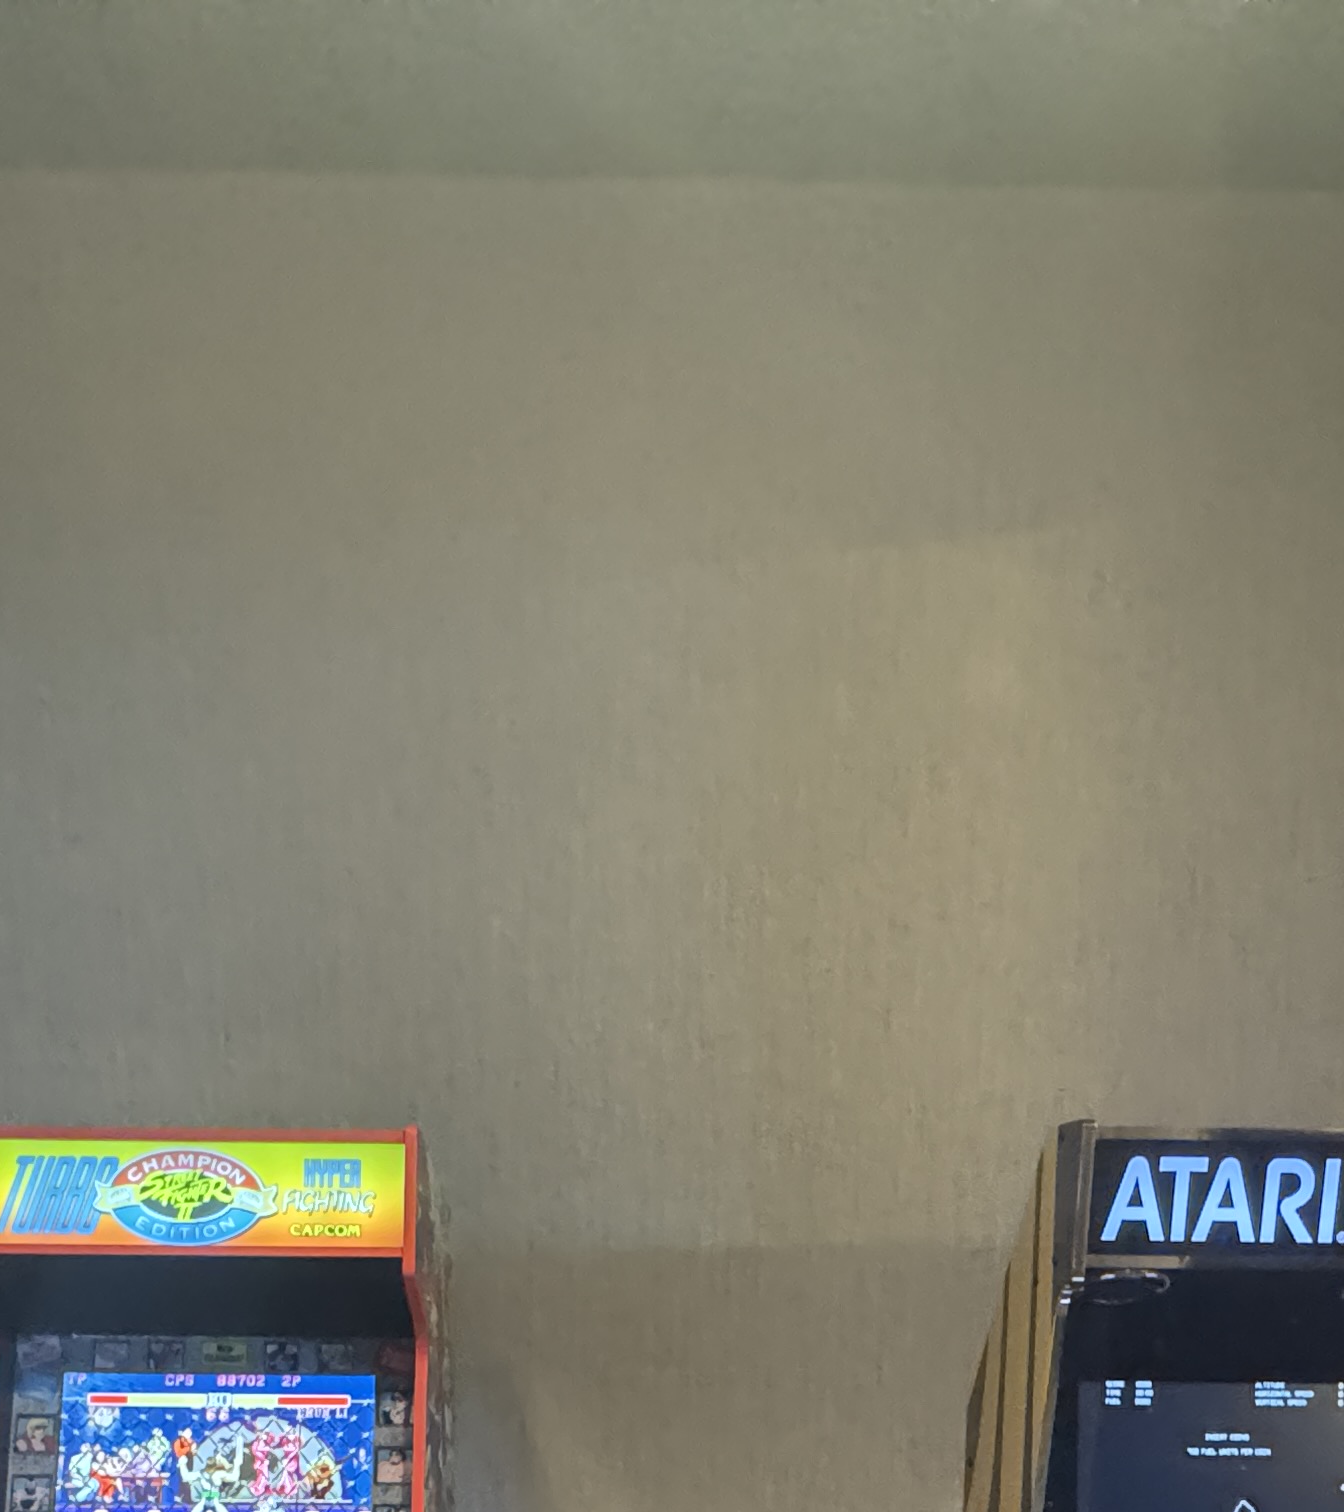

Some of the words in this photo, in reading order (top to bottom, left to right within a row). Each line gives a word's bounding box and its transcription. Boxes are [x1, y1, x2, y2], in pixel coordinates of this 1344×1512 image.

[127, 1153, 246, 1185] CHAMPION
[303, 1158, 362, 1188] HYPER
[283, 1188, 376, 1216] FIGHTING
[1101, 1156, 1342, 1244] ATARI
[134, 1217, 236, 1240] EDITION
[289, 1223, 361, 1238] CAPCOM
